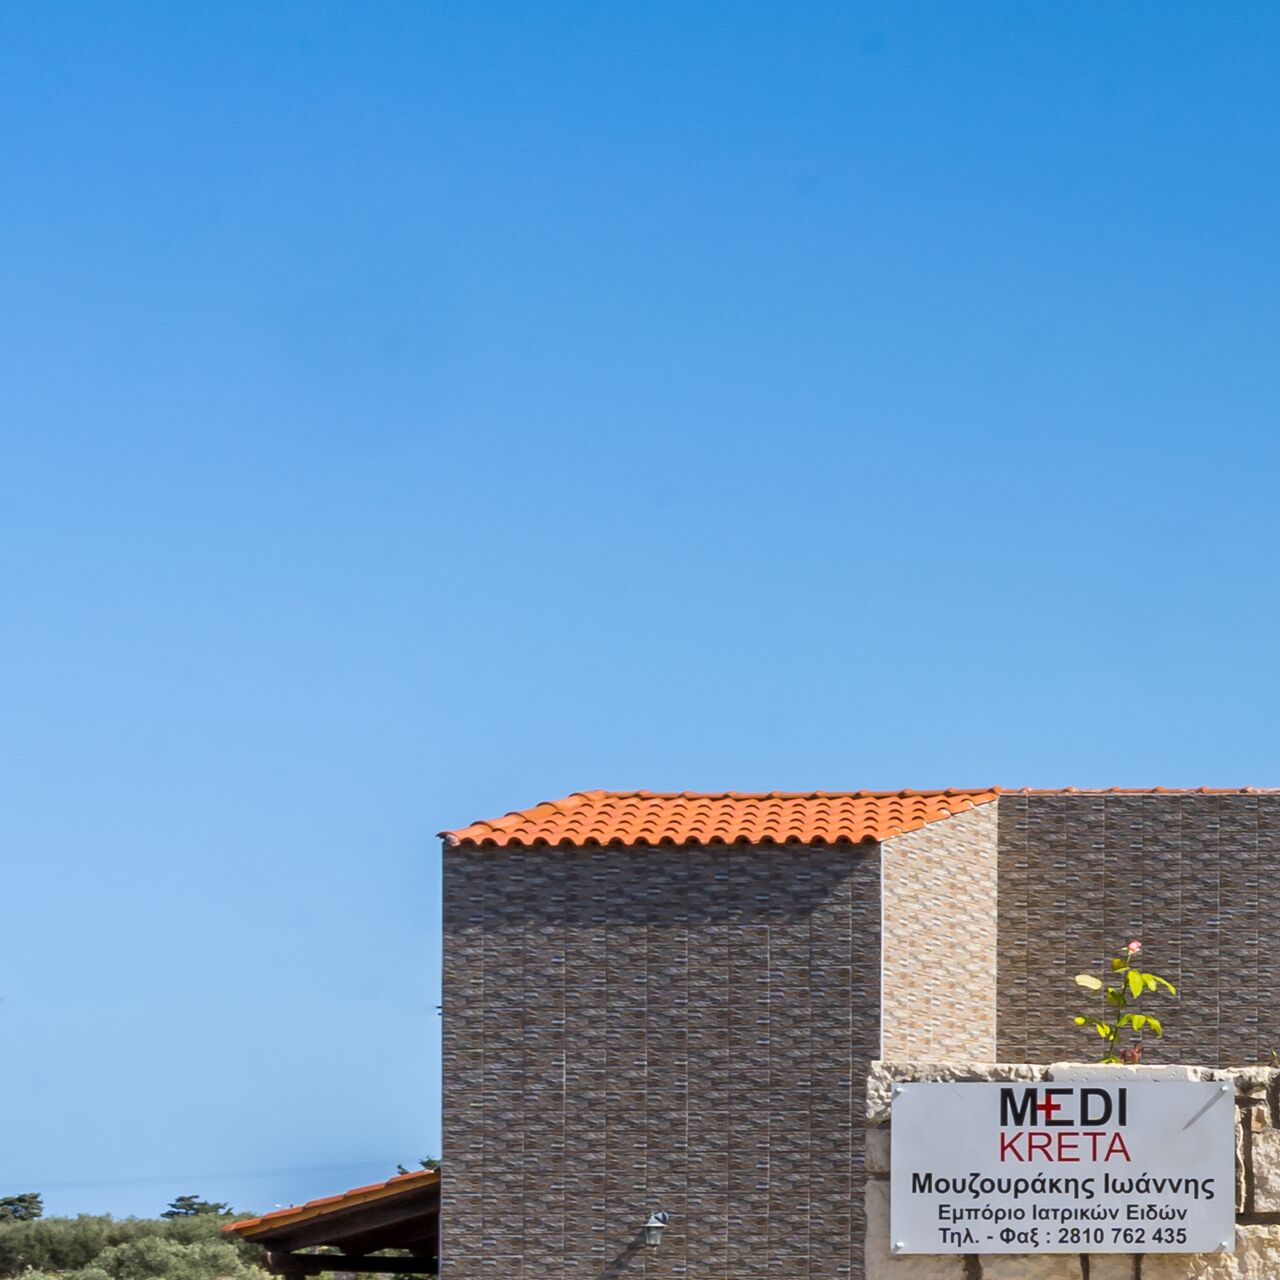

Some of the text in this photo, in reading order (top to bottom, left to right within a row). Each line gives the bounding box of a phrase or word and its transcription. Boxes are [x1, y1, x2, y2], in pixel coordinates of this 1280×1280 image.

[1000, 1087, 1127, 1127] MEDI
[1000, 1131, 1131, 1162] KRETA
[911, 1172, 1215, 1200] Μουζουράκης Ιωάννης
[938, 1203, 1188, 1225] Εμπόριο Ιατρικών Ειδών
[938, 1228, 980, 1247] Τηλ.
[999, 1228, 1040, 1247] Φαξ
[1058, 1228, 1104, 1244] 2810
[1111, 1228, 1145, 1244] 762
[1151, 1228, 1187, 1244] 435
